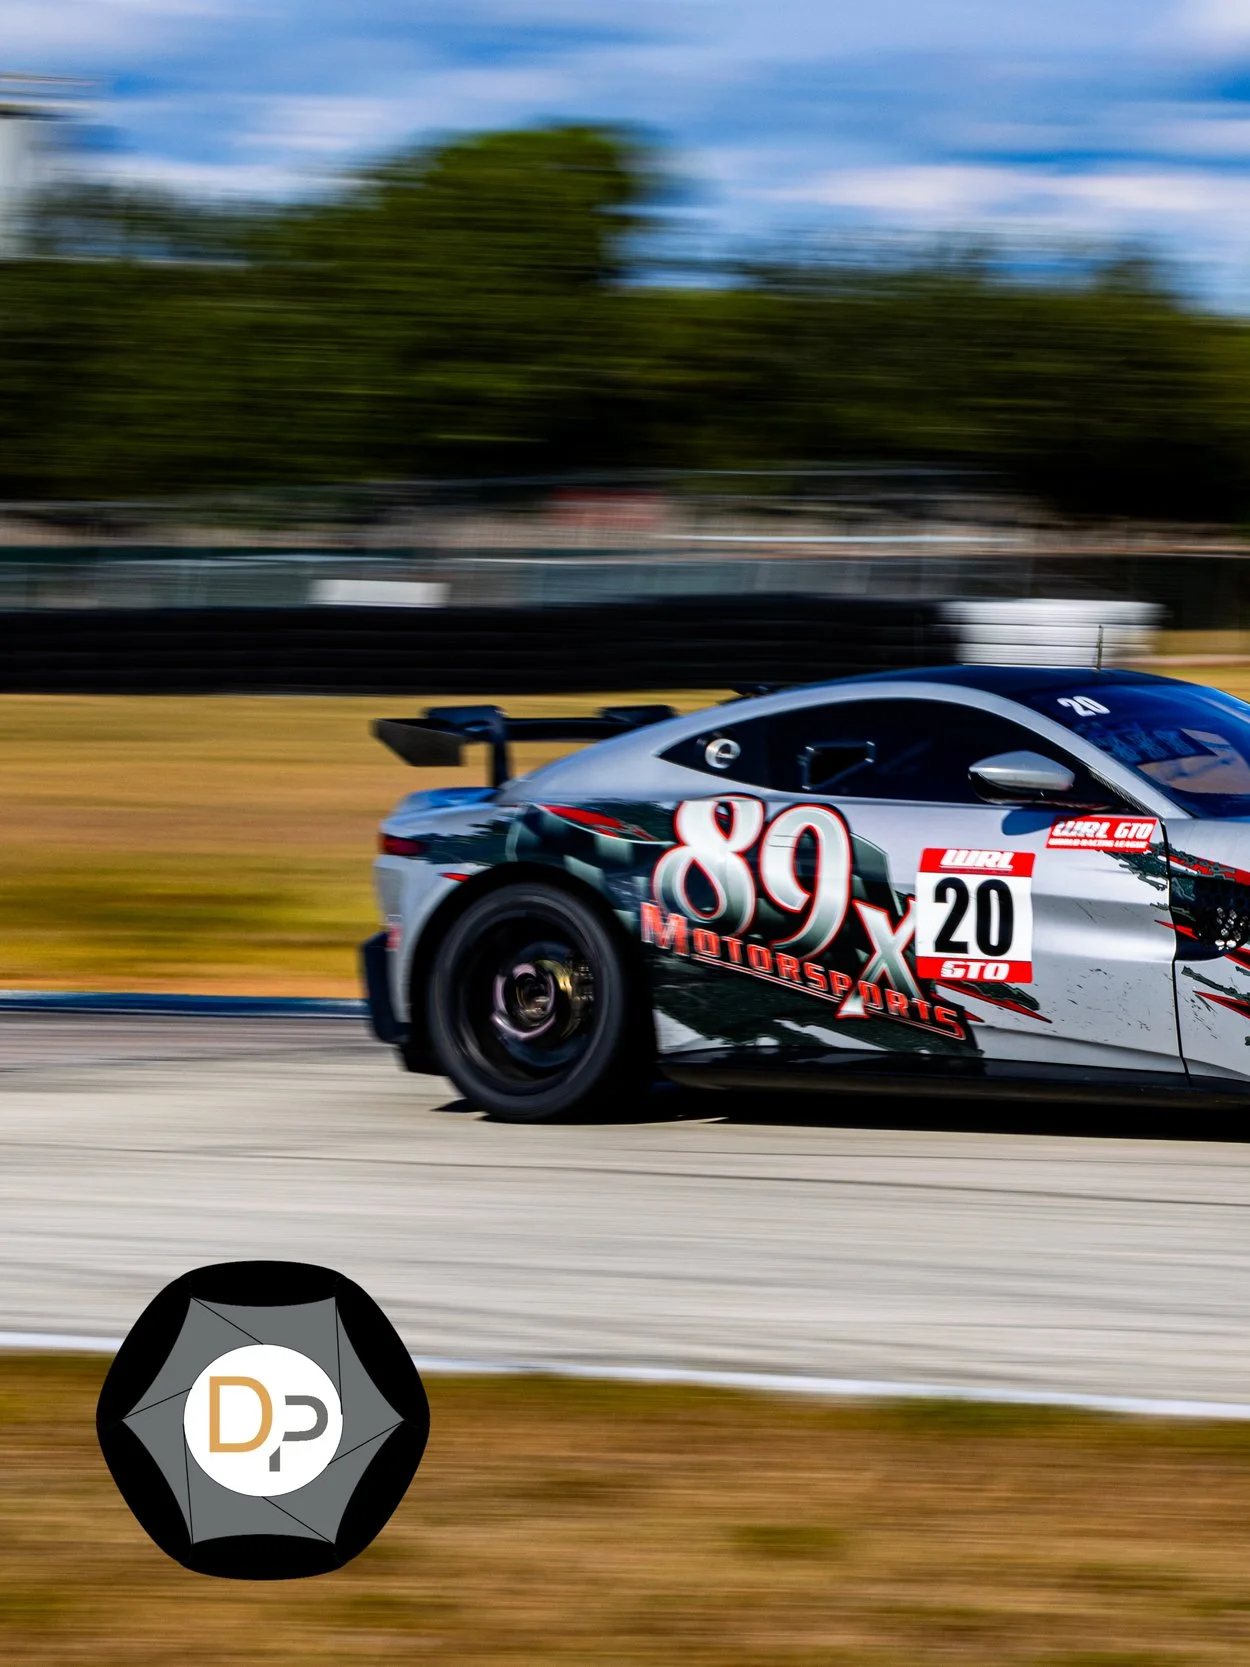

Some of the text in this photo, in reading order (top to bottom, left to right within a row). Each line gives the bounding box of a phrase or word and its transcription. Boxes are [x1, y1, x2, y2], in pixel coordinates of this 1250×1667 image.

[1056, 695, 1111, 718] 20
[1051, 820, 1154, 839] WRL GTO
[939, 849, 1015, 868] WRL
[934, 876, 1014, 957] 20
[940, 960, 1010, 980] GTO
